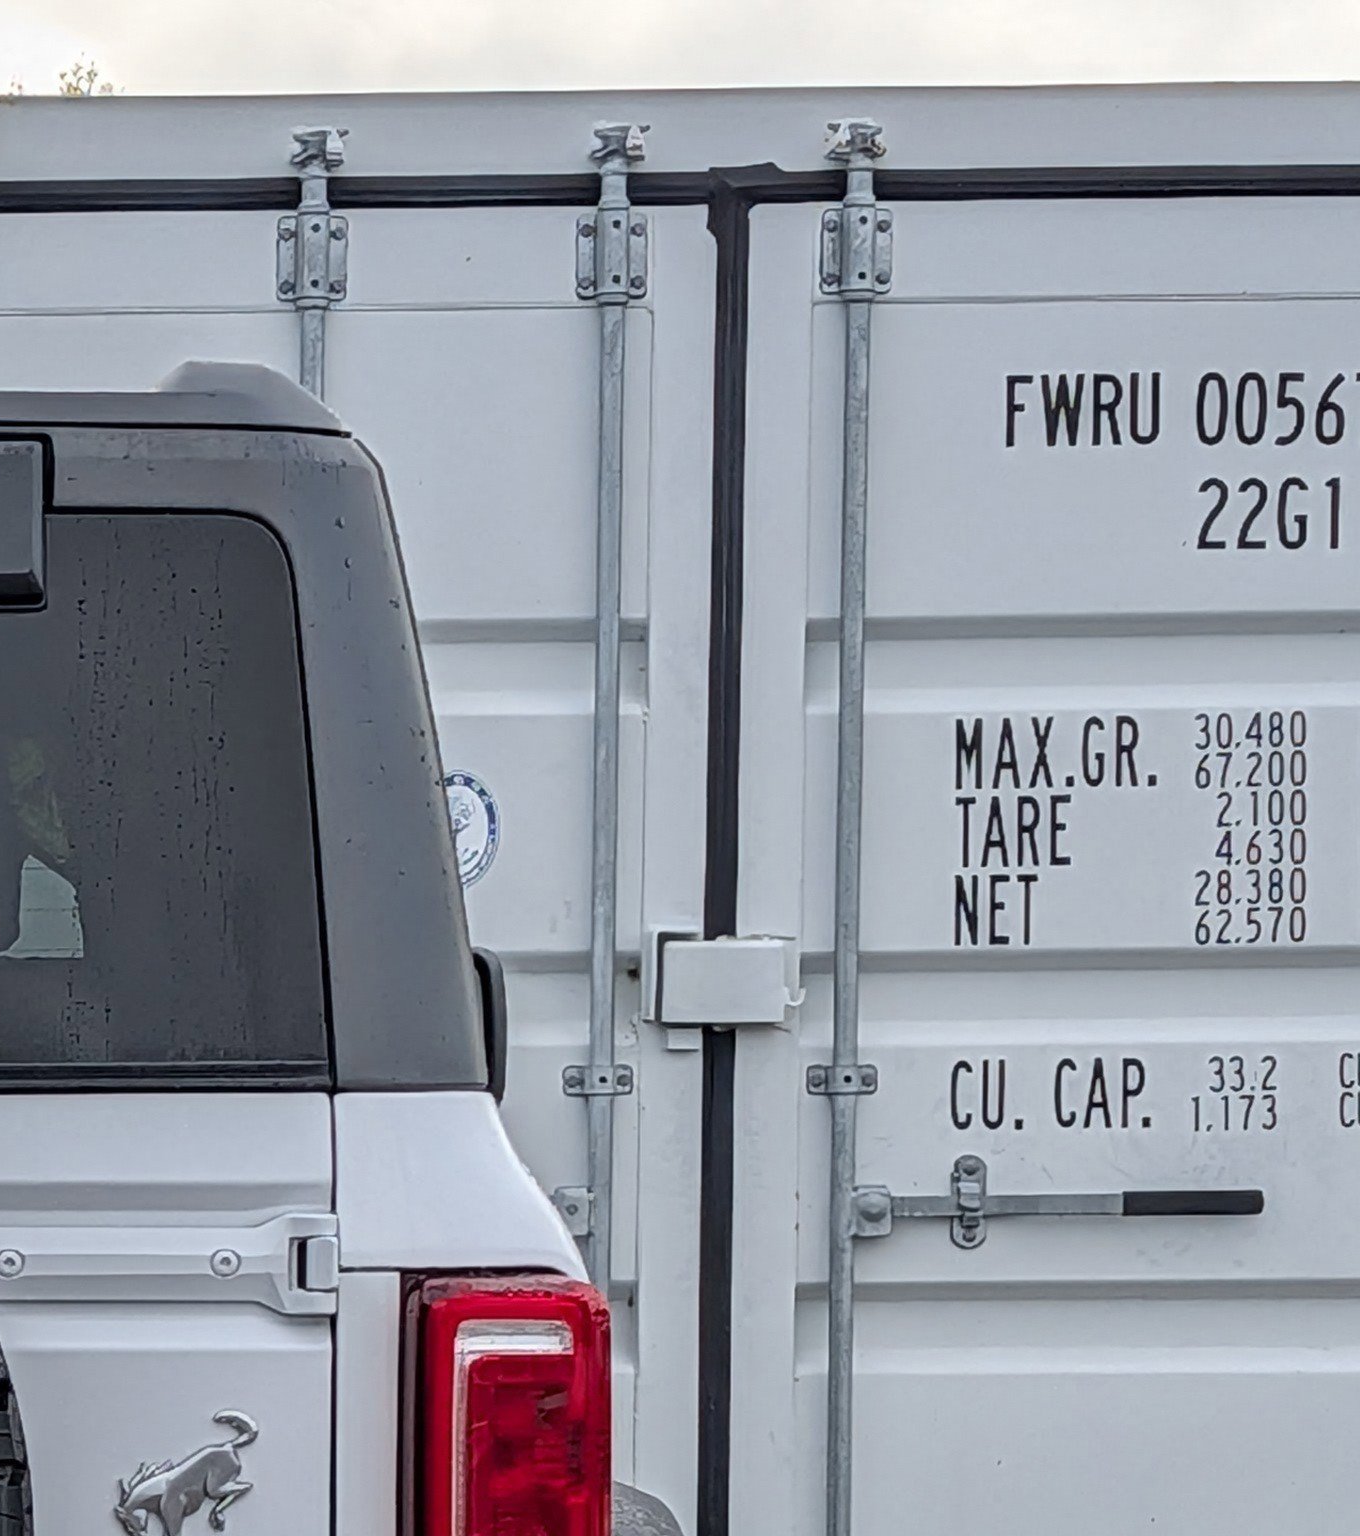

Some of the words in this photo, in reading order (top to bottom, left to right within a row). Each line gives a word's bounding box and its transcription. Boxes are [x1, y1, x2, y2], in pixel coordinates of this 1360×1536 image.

[1005, 371, 1161, 448] FWRU
[1196, 371, 1360, 447] 0056
[1196, 476, 1341, 550] 22G1
[955, 794, 1072, 868] TARE
[954, 873, 1039, 946] NET
[950, 1059, 1024, 1131] CU.
[1054, 1057, 1151, 1129] CAP.
[1208, 1055, 1277, 1093] 33.2
[1339, 1052, 1360, 1089] C
[1339, 1091, 1360, 1128] C
